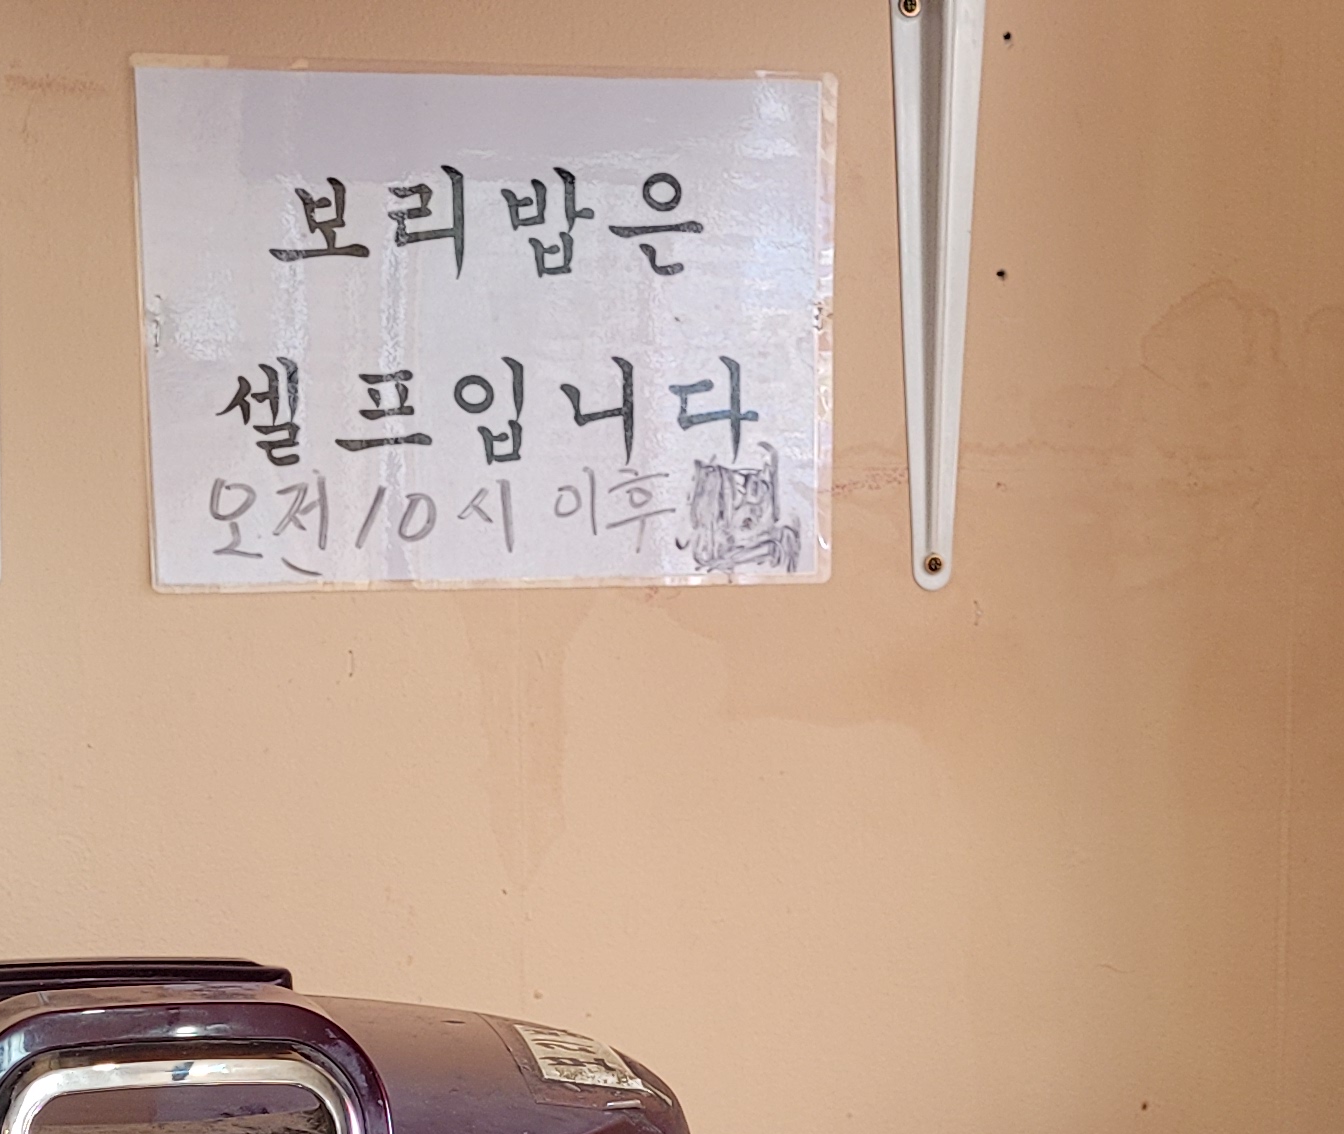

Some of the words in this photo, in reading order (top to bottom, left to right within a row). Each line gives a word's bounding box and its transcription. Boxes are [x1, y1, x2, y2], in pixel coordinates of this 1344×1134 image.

[268, 164, 705, 280] 보리밥은
[216, 355, 760, 467] 셀프입니다
[554, 466, 678, 553] 이후
